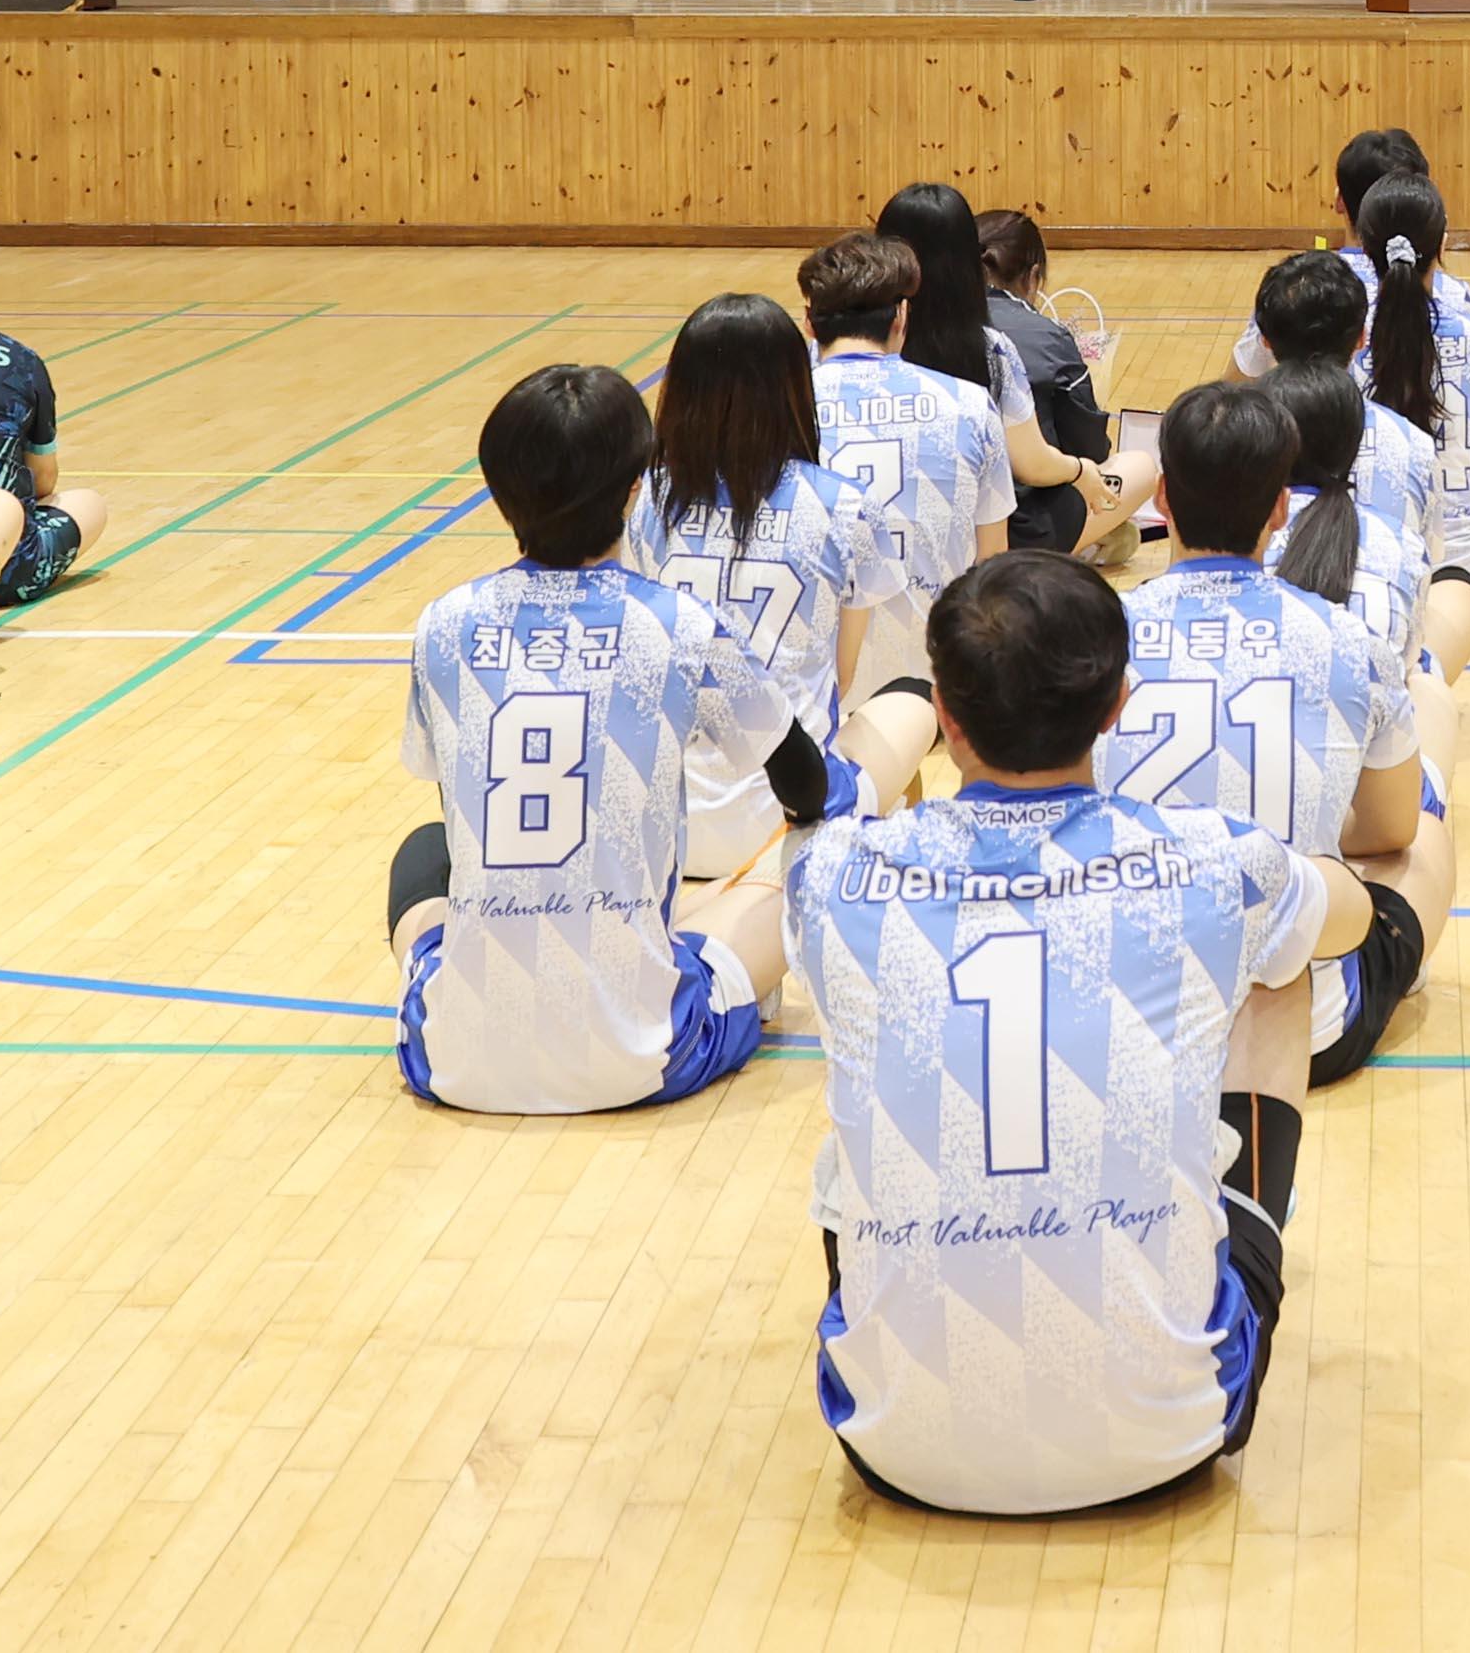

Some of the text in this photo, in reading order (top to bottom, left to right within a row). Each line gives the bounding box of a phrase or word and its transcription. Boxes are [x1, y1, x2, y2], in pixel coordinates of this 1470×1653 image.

[817, 392, 938, 430] OLIDEO
[471, 623, 621, 671] 최종규
[1133, 618, 1281, 661] 임동우
[482, 691, 590, 871] 8
[1114, 678, 1297, 846] 21
[973, 802, 1065, 827] VAMOS
[479, 891, 575, 919] Valuable
[582, 889, 655, 925] Player
[948, 930, 1050, 1178] 1
[855, 1198, 1181, 1251] Most Valuable Player
